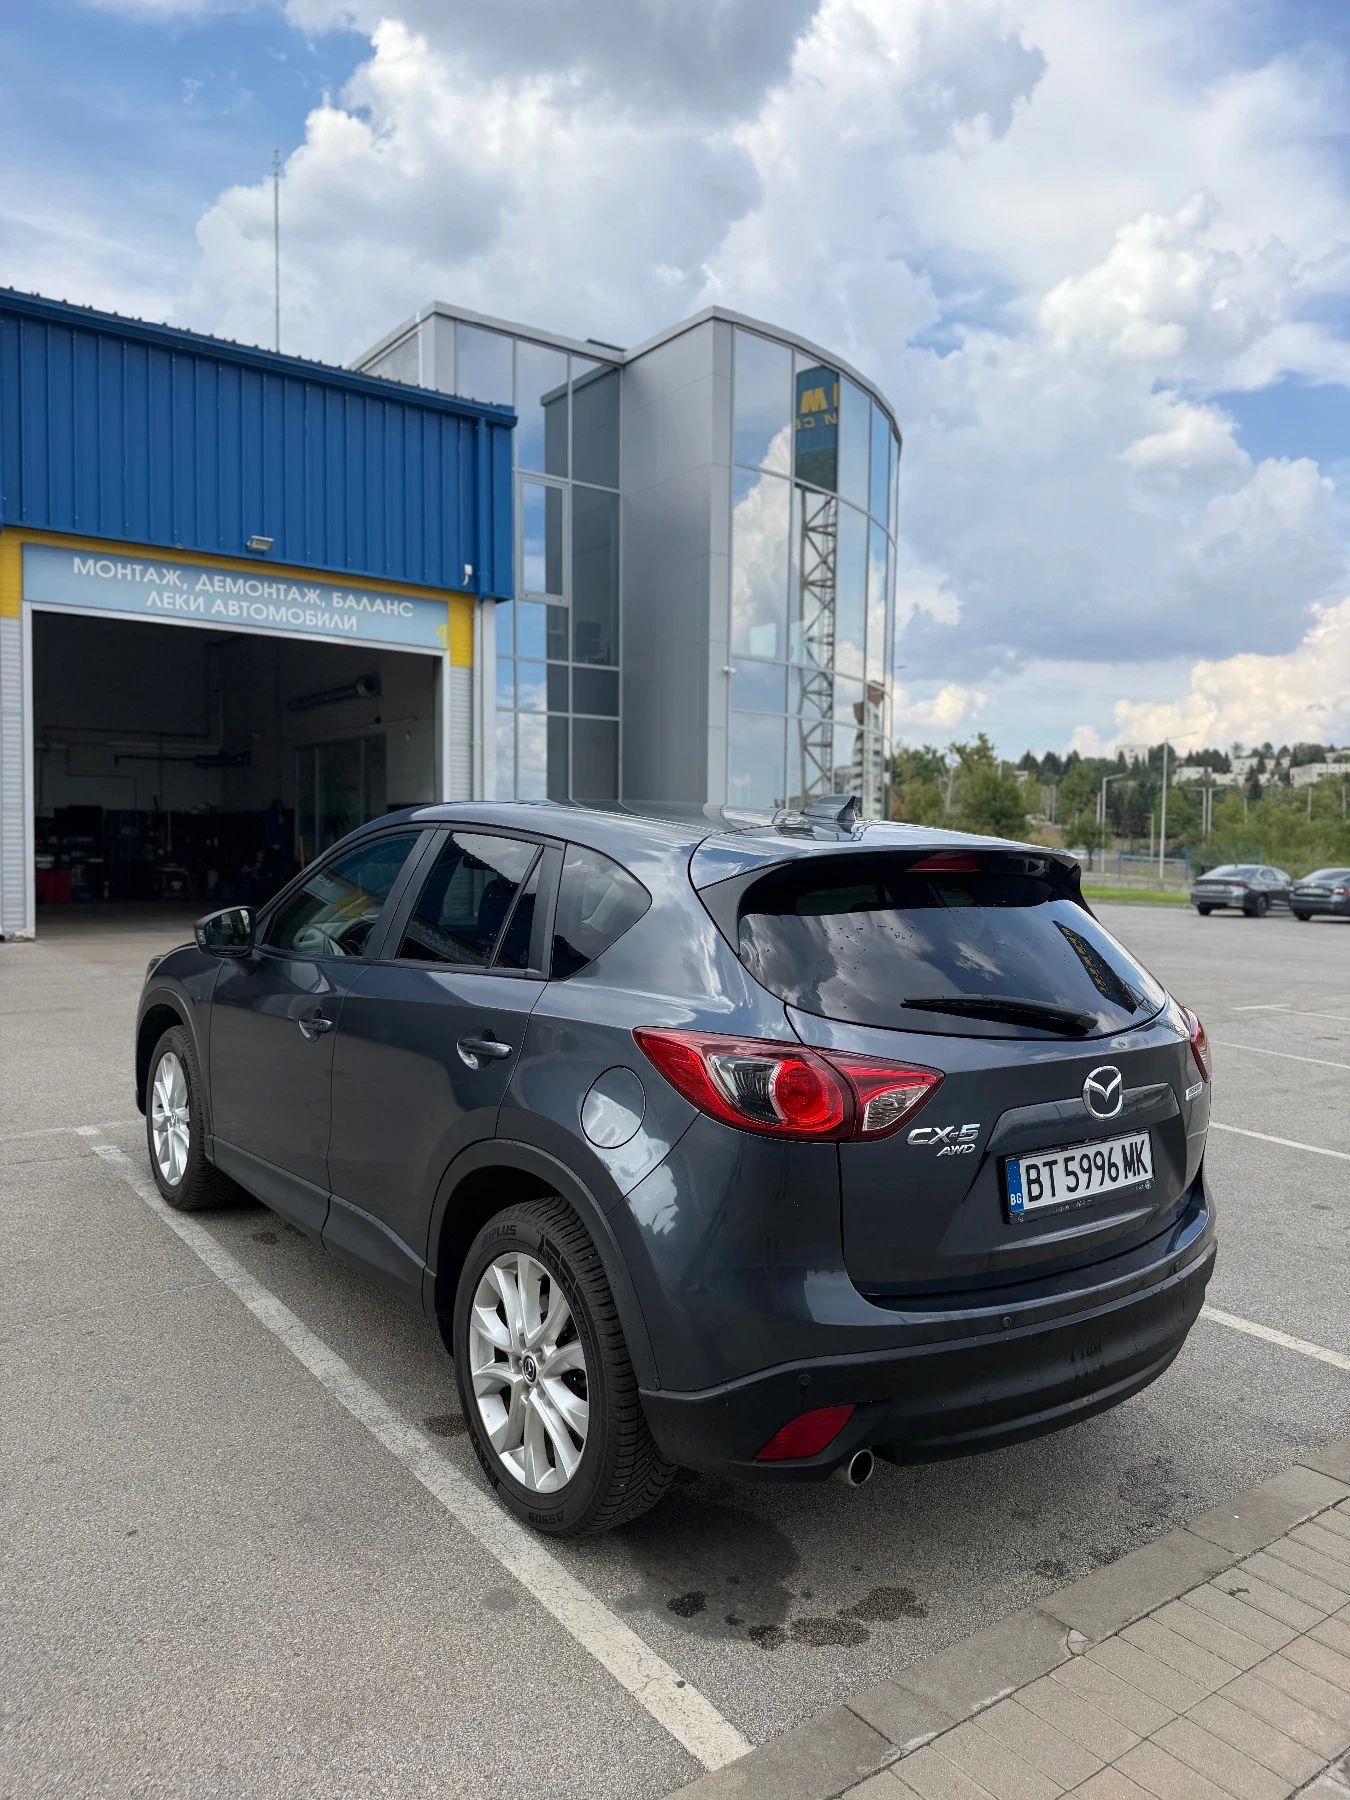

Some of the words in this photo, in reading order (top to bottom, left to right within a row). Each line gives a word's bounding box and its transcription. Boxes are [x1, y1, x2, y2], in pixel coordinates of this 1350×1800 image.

[72, 557, 188, 591] МОНТАЖ,
[195, 572, 326, 608] ДЕМОНТАЖ,
[333, 591, 415, 619] БАЛАНС
[146, 590, 206, 613] ЛЕКИ
[211, 598, 358, 632] АВТОМОБИЛИ
[435, 624, 448, 649] 1
[907, 1123, 981, 1145] CX-5
[936, 1144, 976, 1157] AWD
[1025, 1159, 1059, 1203] BT
[1063, 1147, 1120, 1193] 5996
[1121, 1139, 1149, 1180] MK
[1010, 1192, 1022, 1206] BG
